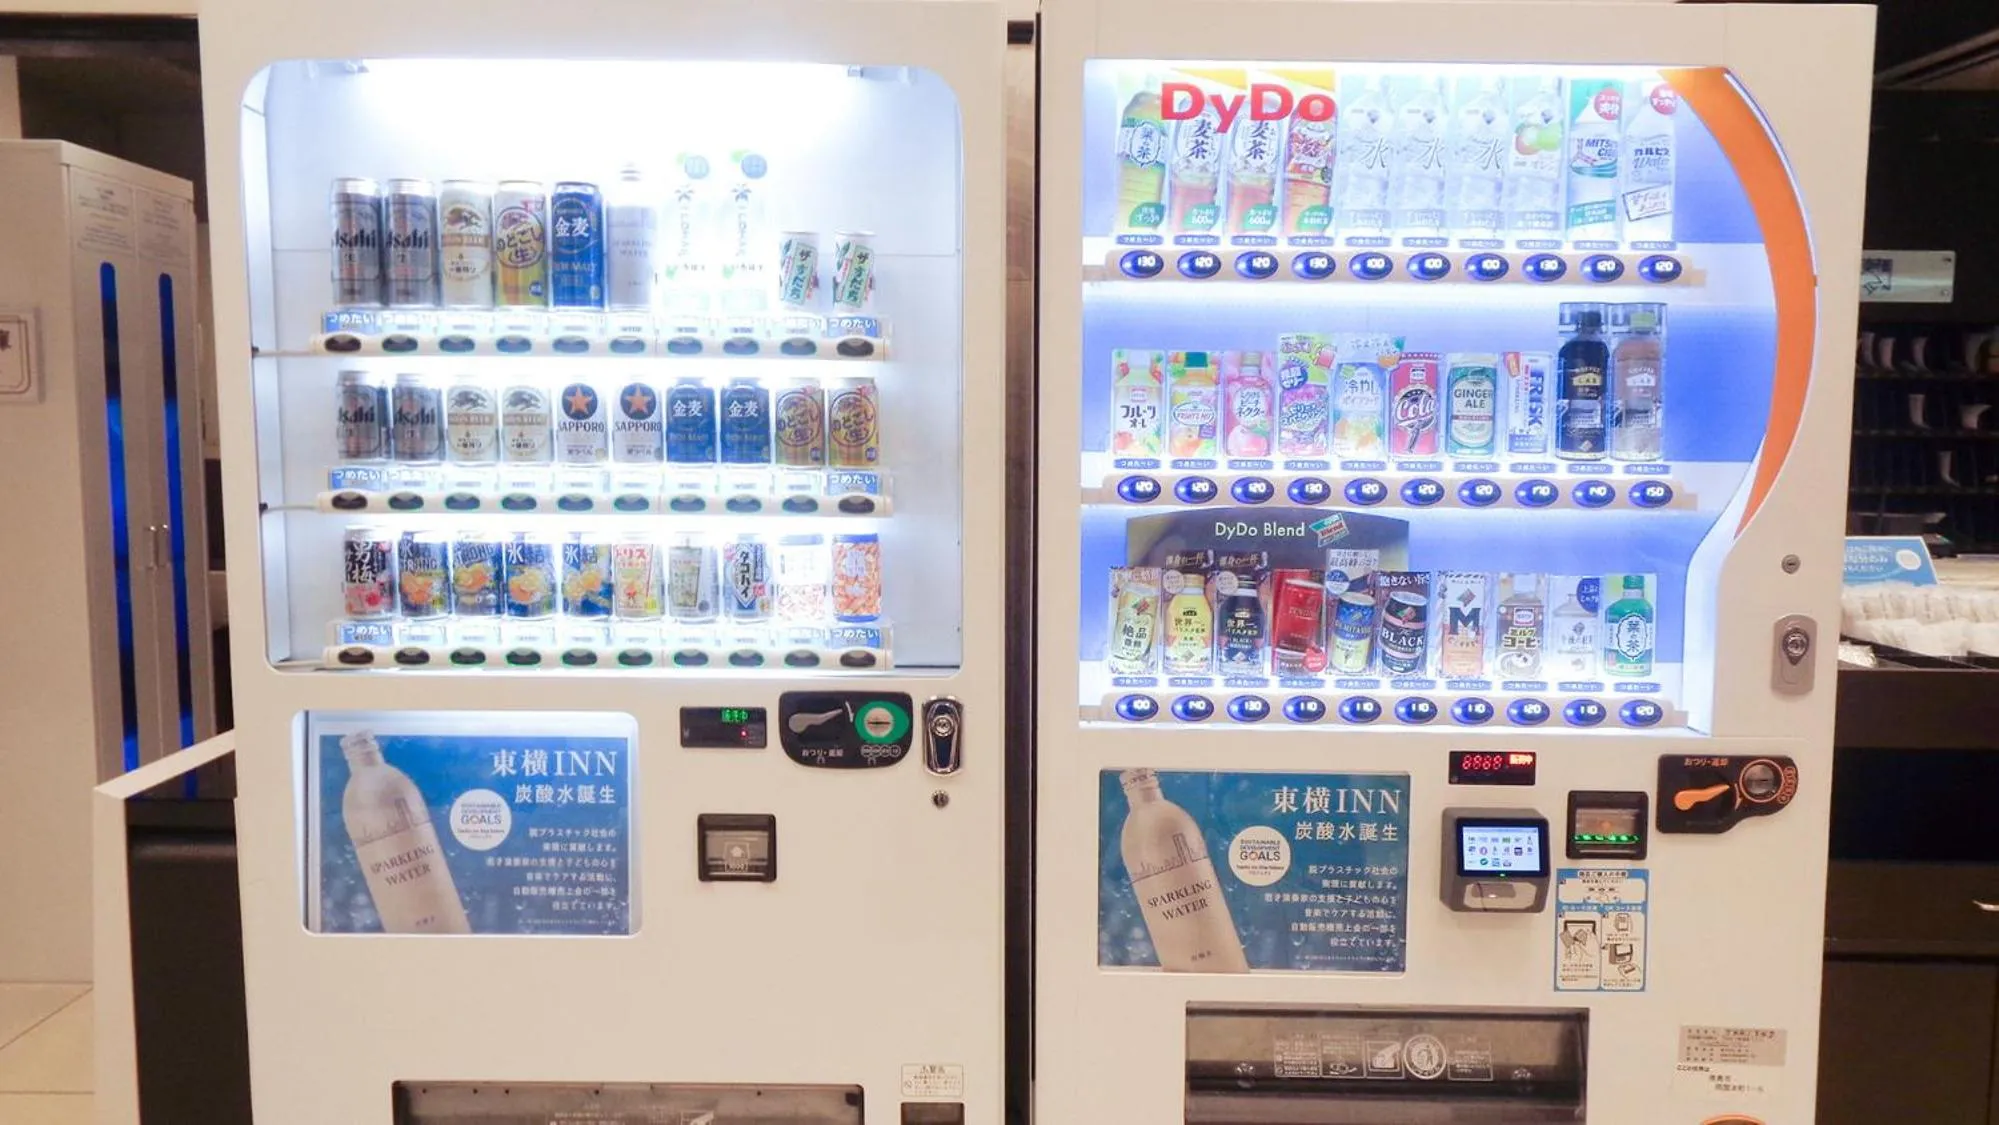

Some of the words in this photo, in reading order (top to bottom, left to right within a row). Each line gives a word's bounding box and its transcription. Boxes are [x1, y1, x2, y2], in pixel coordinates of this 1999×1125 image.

[1160, 83, 1336, 133] DyDo
[1362, 137, 1388, 169] 水
[1422, 137, 1445, 169] 水
[1481, 137, 1503, 169] 水
[555, 217, 590, 237] 金麦
[1139, 256, 1155, 266] 130
[1196, 257, 1213, 267] 120
[1253, 258, 1270, 267] 120
[1311, 258, 1327, 268] 130
[1598, 261, 1615, 270] 120
[1656, 261, 1673, 271] 120
[329, 313, 375, 324] つめたい
[829, 319, 877, 329] つめたい
[1454, 388, 1494, 399] GINGER
[1528, 369, 1545, 426] FRISK
[672, 400, 703, 417] 金麦
[727, 400, 758, 417] 金麦
[1395, 398, 1435, 420] Cola
[1464, 399, 1486, 409] ALE
[558, 421, 605, 433] SAPPORO
[615, 421, 662, 432] SAPPORO
[333, 470, 381, 481] つめたい
[830, 474, 876, 485] つめたい
[1137, 482, 1153, 491] 120
[1193, 482, 1209, 492] 120
[1249, 483, 1266, 492] 120
[1306, 480, 1324, 493] 130
[1362, 484, 1379, 493] 120
[1420, 485, 1435, 494] 120
[1477, 485, 1493, 494] 120
[1215, 522, 1258, 541] DyDo
[1264, 522, 1306, 537] Blend
[615, 547, 648, 559] トリス
[738, 550, 752, 599] タコハイ
[1449, 607, 1482, 636] M
[347, 626, 391, 635] つめたい
[832, 629, 878, 639] つめたい
[1122, 624, 1147, 640] 絶品
[1508, 628, 1535, 637] ミルク
[1626, 620, 1641, 652] 葉の茶
[1382, 627, 1424, 647] BLACK
[1301, 702, 1317, 710] 110
[1357, 703, 1373, 711] 110
[1413, 703, 1429, 711] 110
[1469, 704, 1485, 713] 110
[1581, 706, 1597, 714] 110
[491, 749, 618, 776] 東横INN
[514, 784, 616, 804] 炭酸水誕生
[1271, 785, 1402, 815] 東横INN
[461, 814, 502, 825] GOALS
[1294, 821, 1399, 843] 炭酸水誕生
[370, 844, 435, 875] SPARKLING
[1240, 851, 1281, 861] GOALS
[384, 863, 432, 887] WATER
[1147, 879, 1213, 909] SPARKLING
[1161, 897, 1209, 921] WATER
